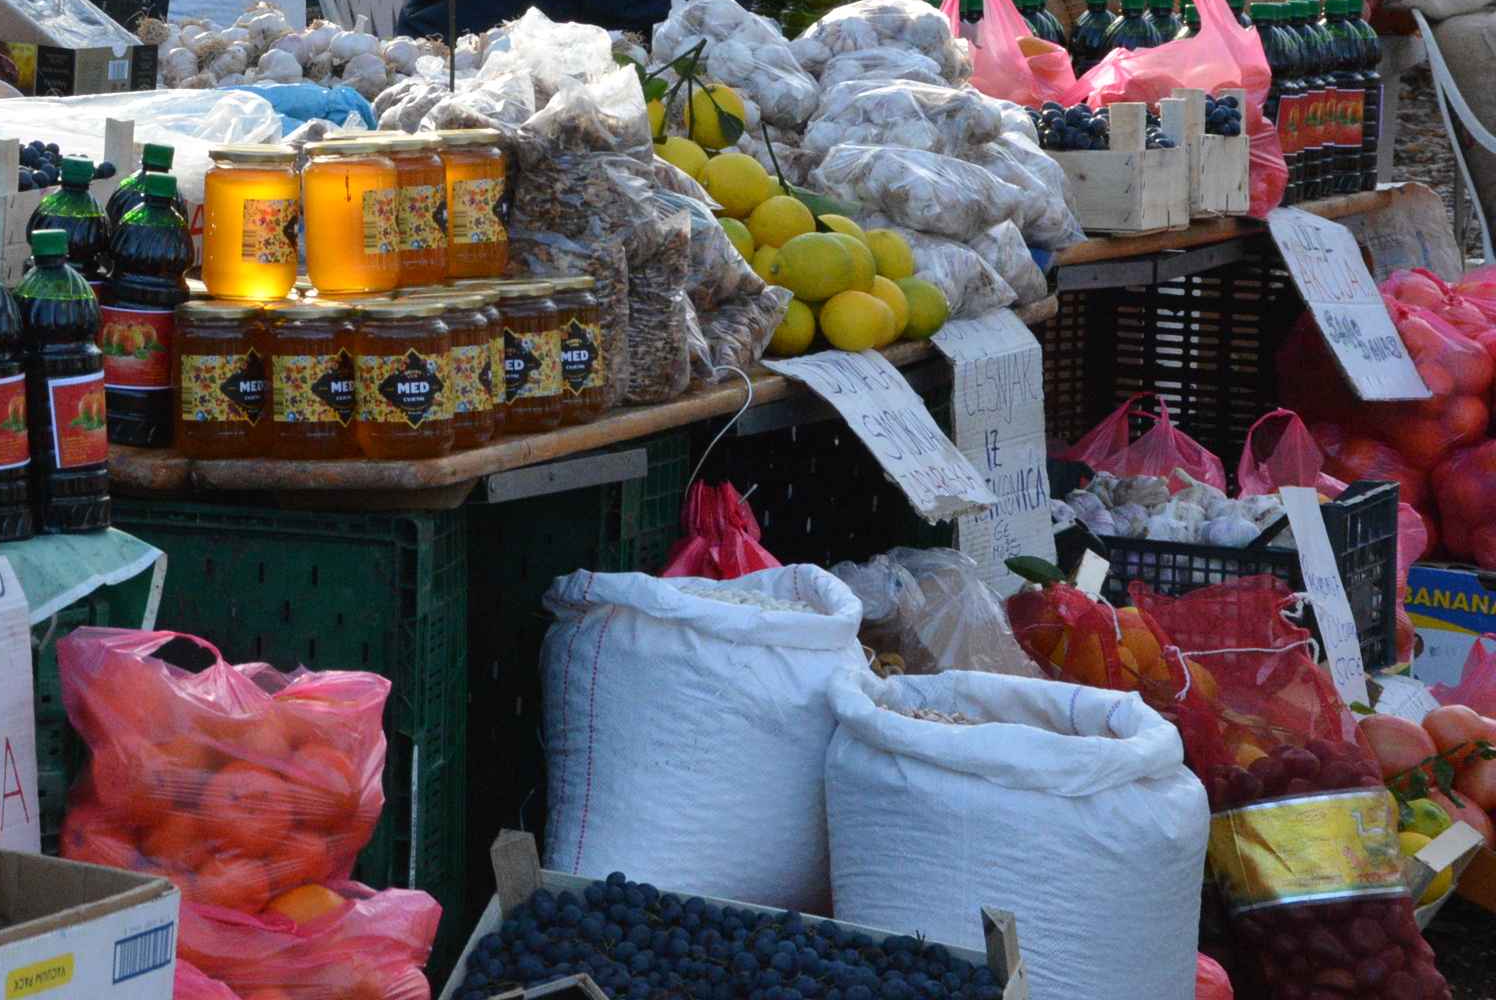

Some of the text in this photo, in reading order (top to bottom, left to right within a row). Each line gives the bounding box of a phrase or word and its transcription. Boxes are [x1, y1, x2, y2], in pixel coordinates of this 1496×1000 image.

[561, 350, 589, 362] MED
[504, 359, 524, 371] ED
[397, 381, 430, 394] MED
